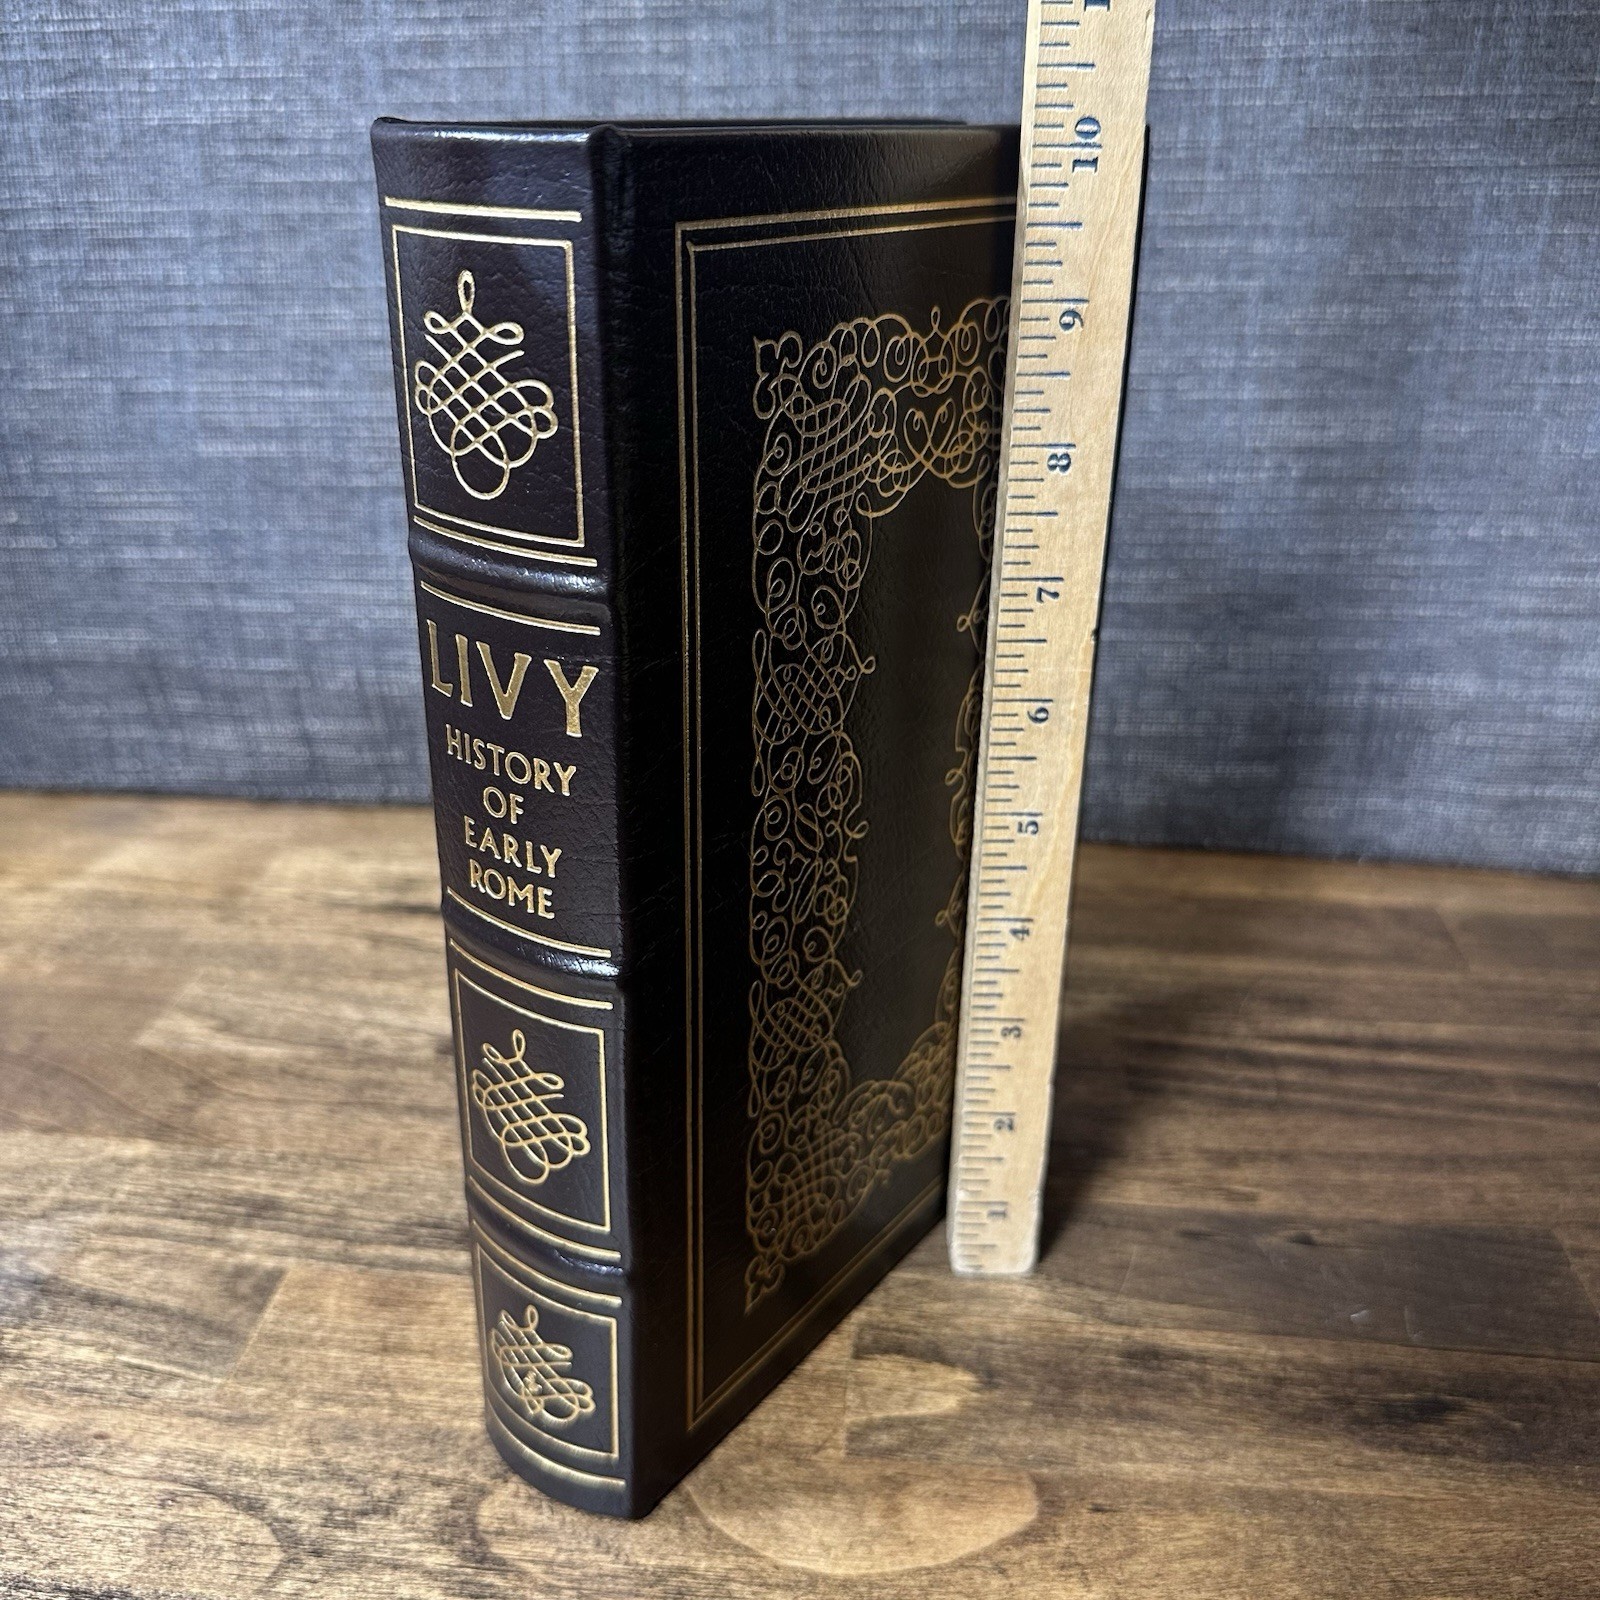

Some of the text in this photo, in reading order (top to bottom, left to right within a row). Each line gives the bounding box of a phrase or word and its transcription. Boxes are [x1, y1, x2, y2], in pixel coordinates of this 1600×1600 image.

[1072, 116, 1102, 174] 10
[1059, 309, 1084, 332] 9
[1046, 452, 1072, 474] 8
[1036, 586, 1060, 603] 7
[426, 619, 599, 738] LIVY
[1026, 706, 1050, 724] 6
[445, 723, 577, 797] HISTORY
[482, 785, 525, 825] OF
[1016, 820, 1040, 836] 5
[463, 815, 563, 879] EARLY
[468, 858, 556, 920] ROME
[1008, 925, 1031, 942] 4
[1000, 1025, 1023, 1040] 3
[992, 1116, 1016, 1133] 2
[986, 1208, 1009, 1221] 1
